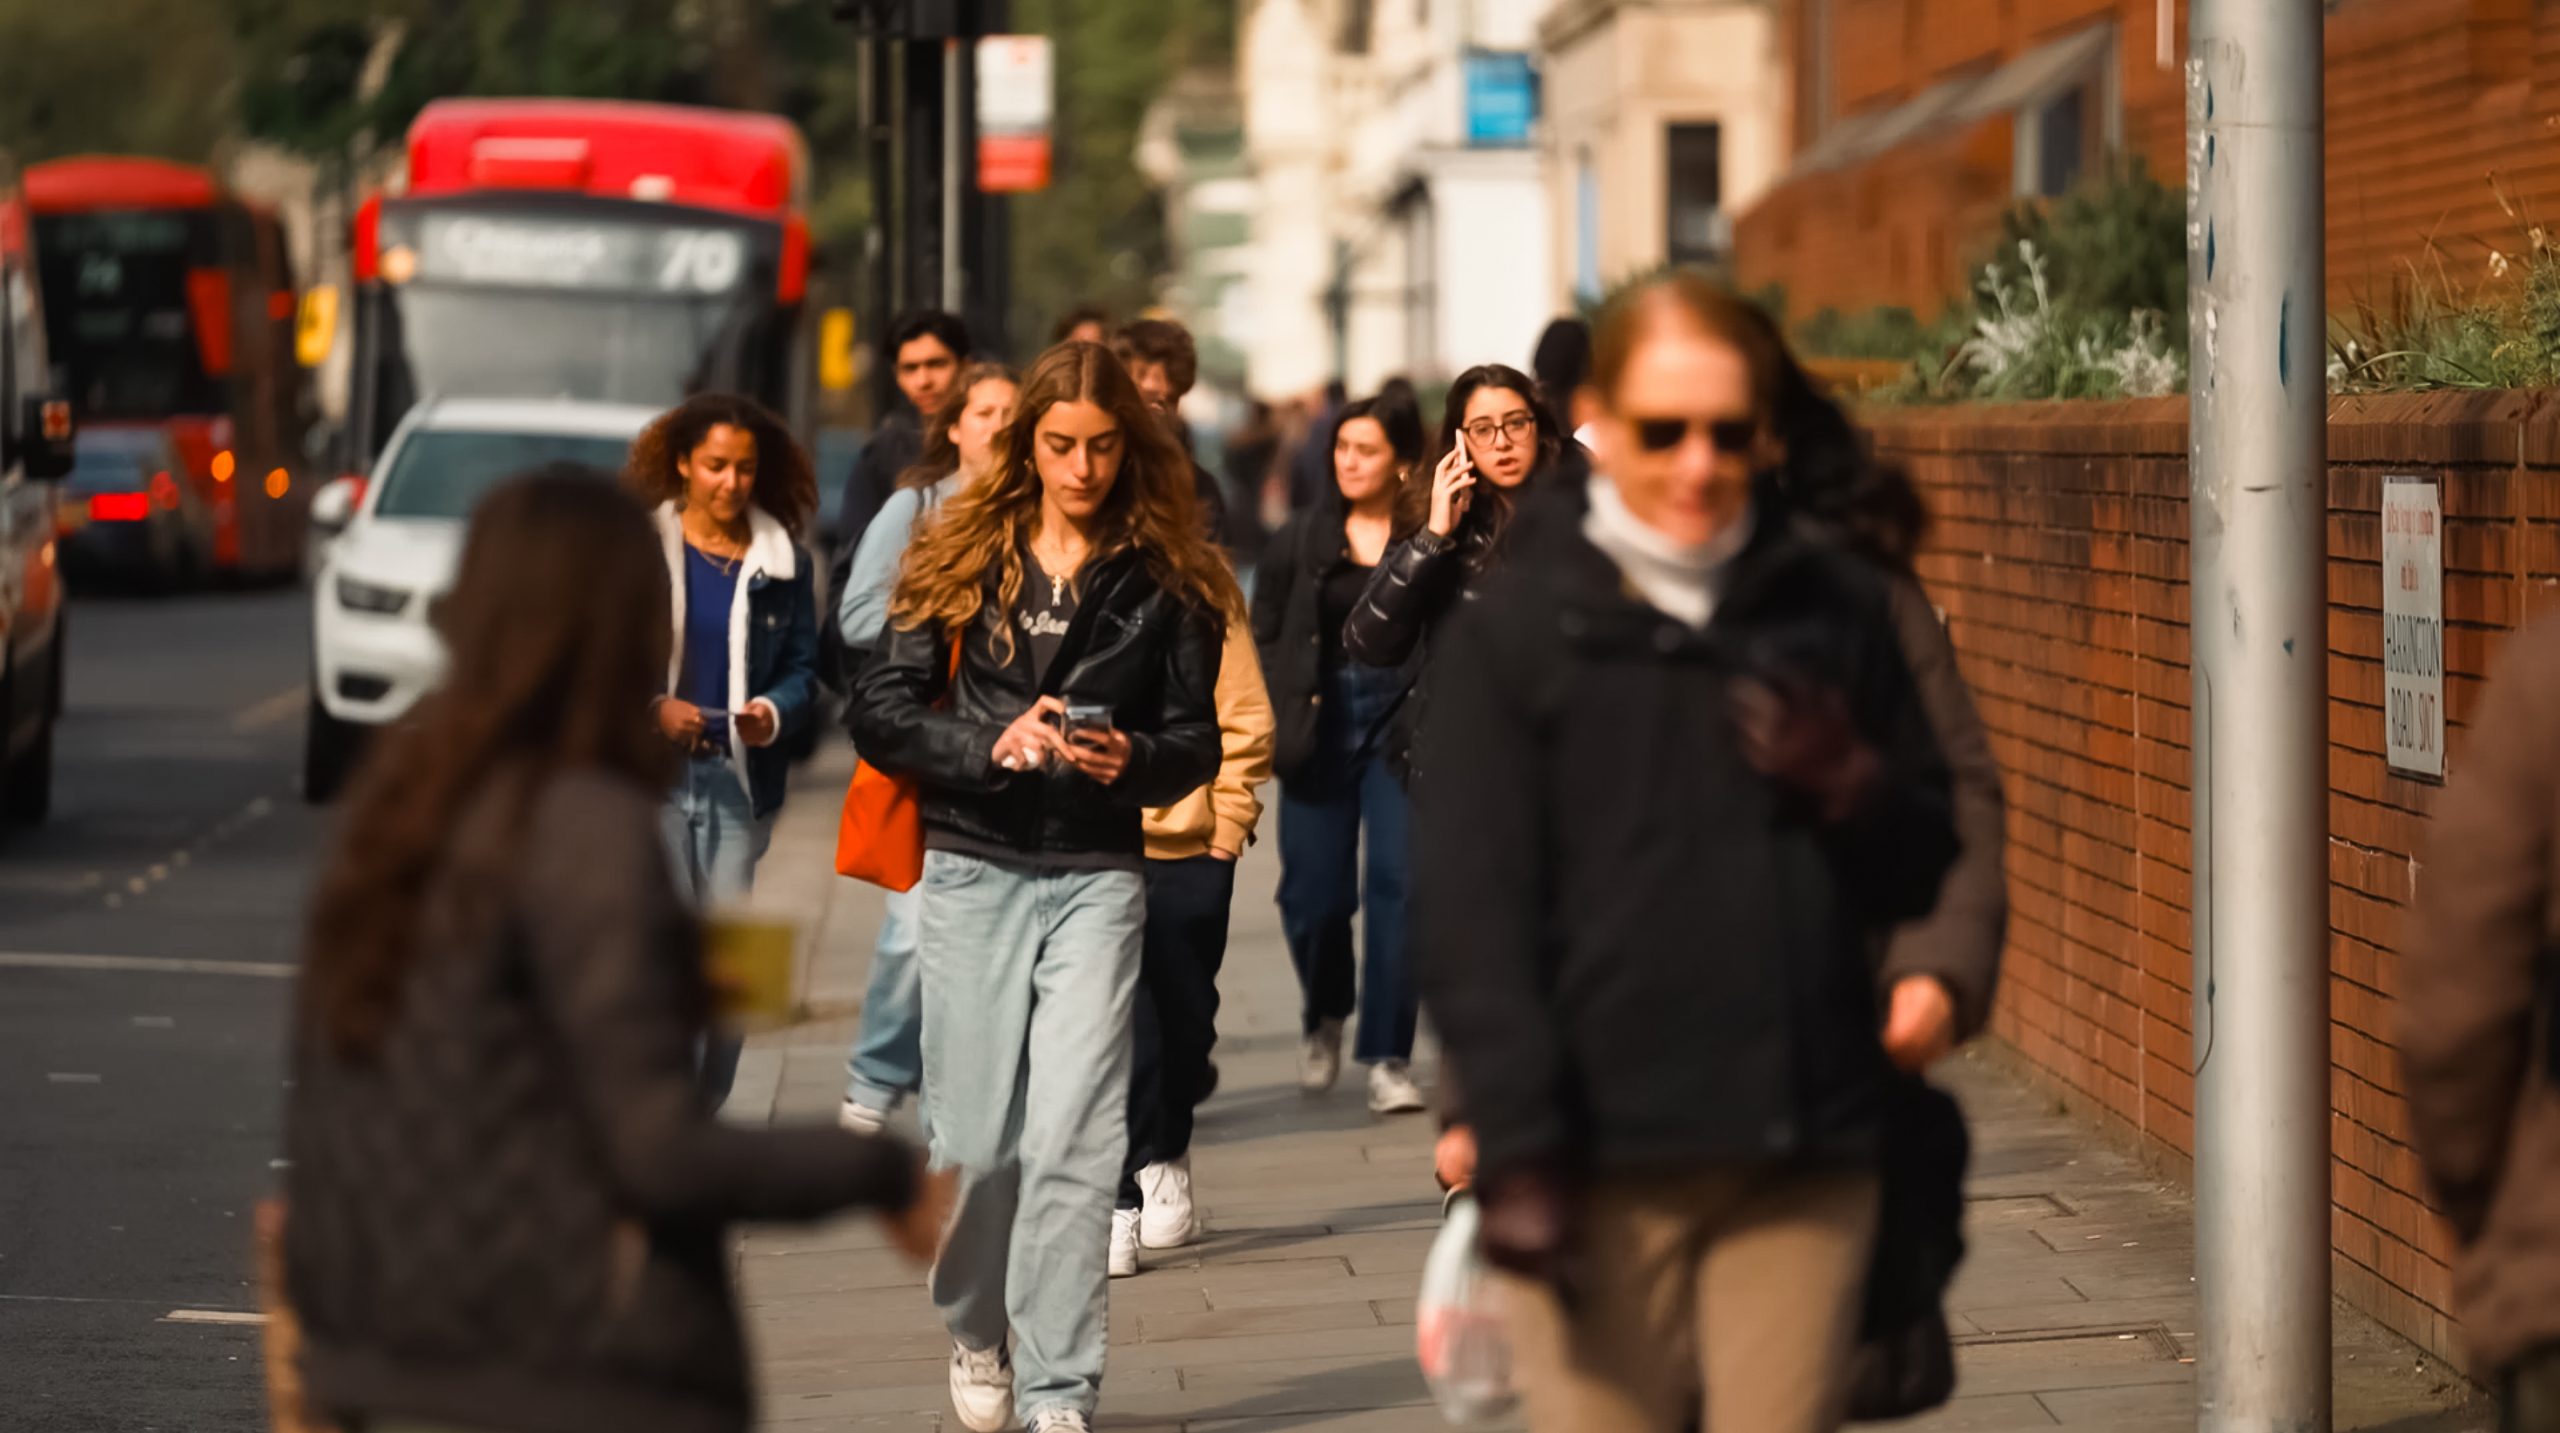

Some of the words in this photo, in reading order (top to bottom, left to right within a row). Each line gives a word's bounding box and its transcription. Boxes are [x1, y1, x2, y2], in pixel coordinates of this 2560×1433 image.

[657, 227, 744, 293] 70
[2385, 612, 2440, 678] HARRINGTON
[2391, 687, 2414, 748] ROAD
